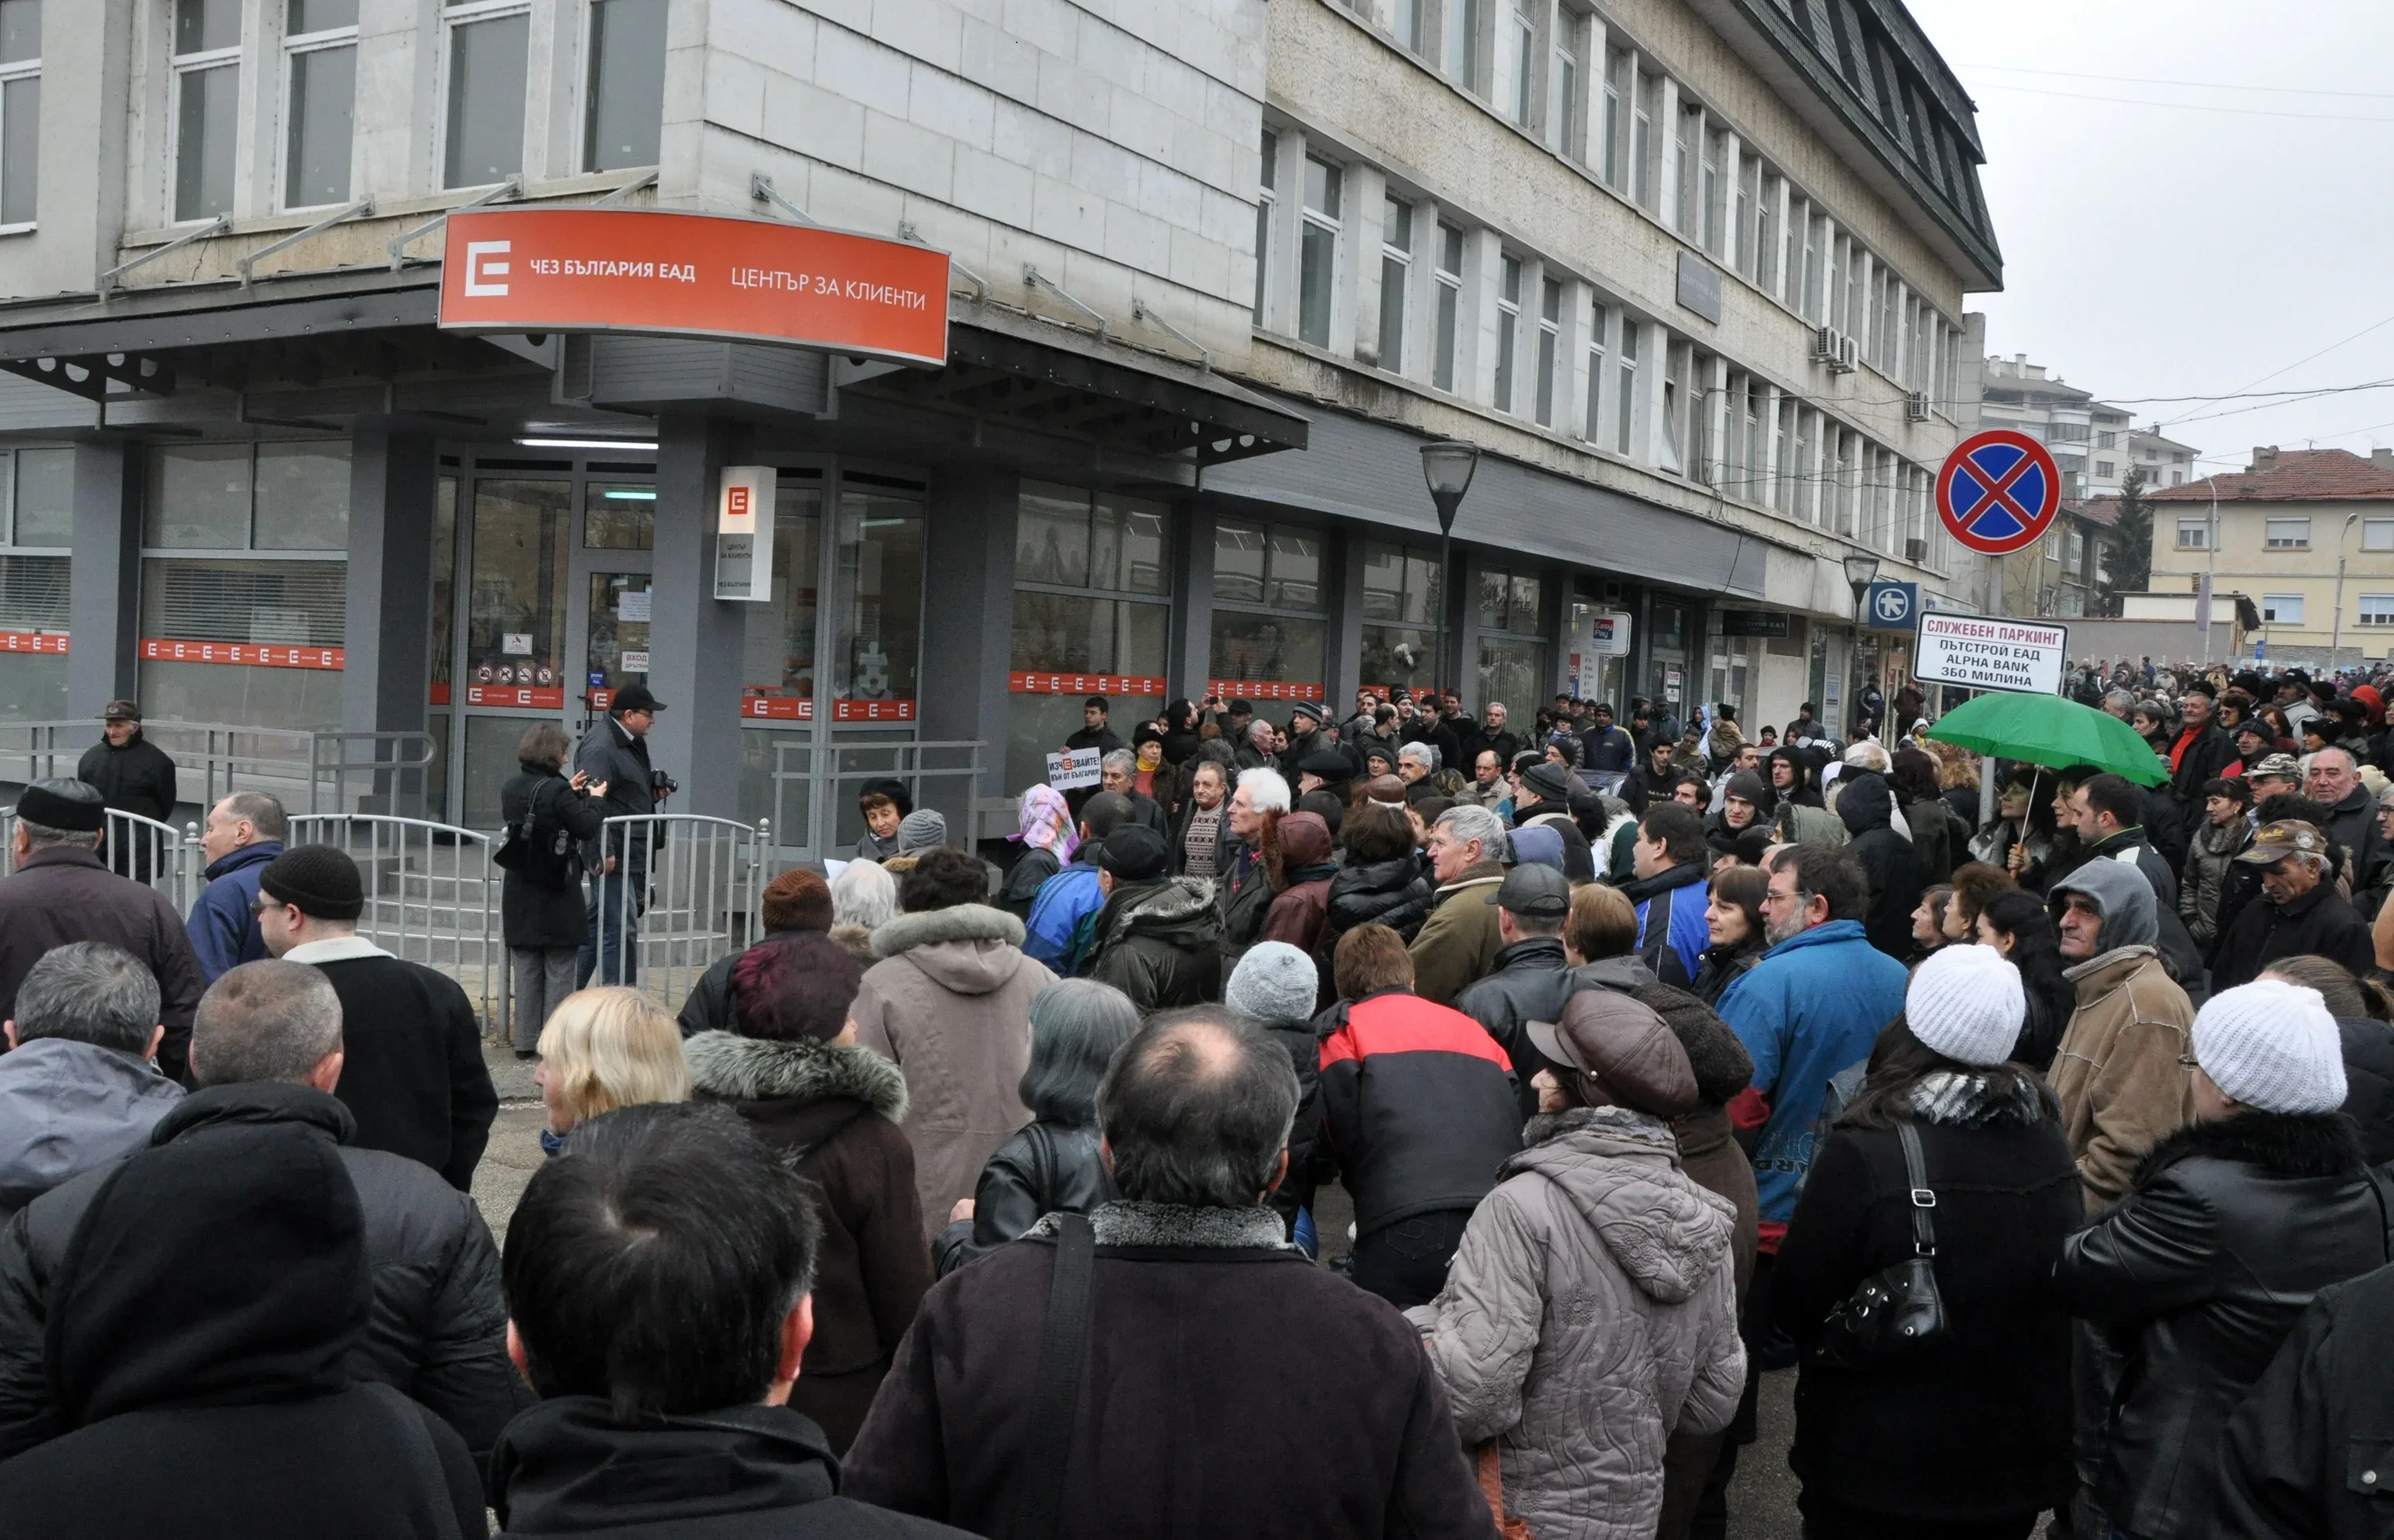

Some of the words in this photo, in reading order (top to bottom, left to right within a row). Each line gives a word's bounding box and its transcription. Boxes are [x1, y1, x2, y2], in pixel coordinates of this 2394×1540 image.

[531, 259, 559, 274] ЧЕЗ
[564, 260, 654, 277] БЪЛГАРИЯ
[658, 263, 696, 282] ЕАД
[731, 267, 809, 291] ЦЕНТЪР
[814, 276, 839, 296] ЗА
[845, 280, 926, 310] КЛИЕНТИ
[1595, 622, 1613, 631] Easy
[1927, 619, 1994, 638] СЛУЖЕБЕН
[1998, 627, 2060, 645] ПАРКИНГ
[1939, 639, 2009, 657] ПЪТСТРОЙ
[2013, 648, 2040, 661] ЕАД
[1946, 654, 1989, 668] ALPHA
[1993, 660, 2030, 673] BANK
[1971, 670, 2032, 686] МИЛИНА
[1049, 756, 1100, 772] ИЗЧЕЗВАЙТЕ!
[1071, 768, 1100, 779] БЪЛГАРИЯ!
